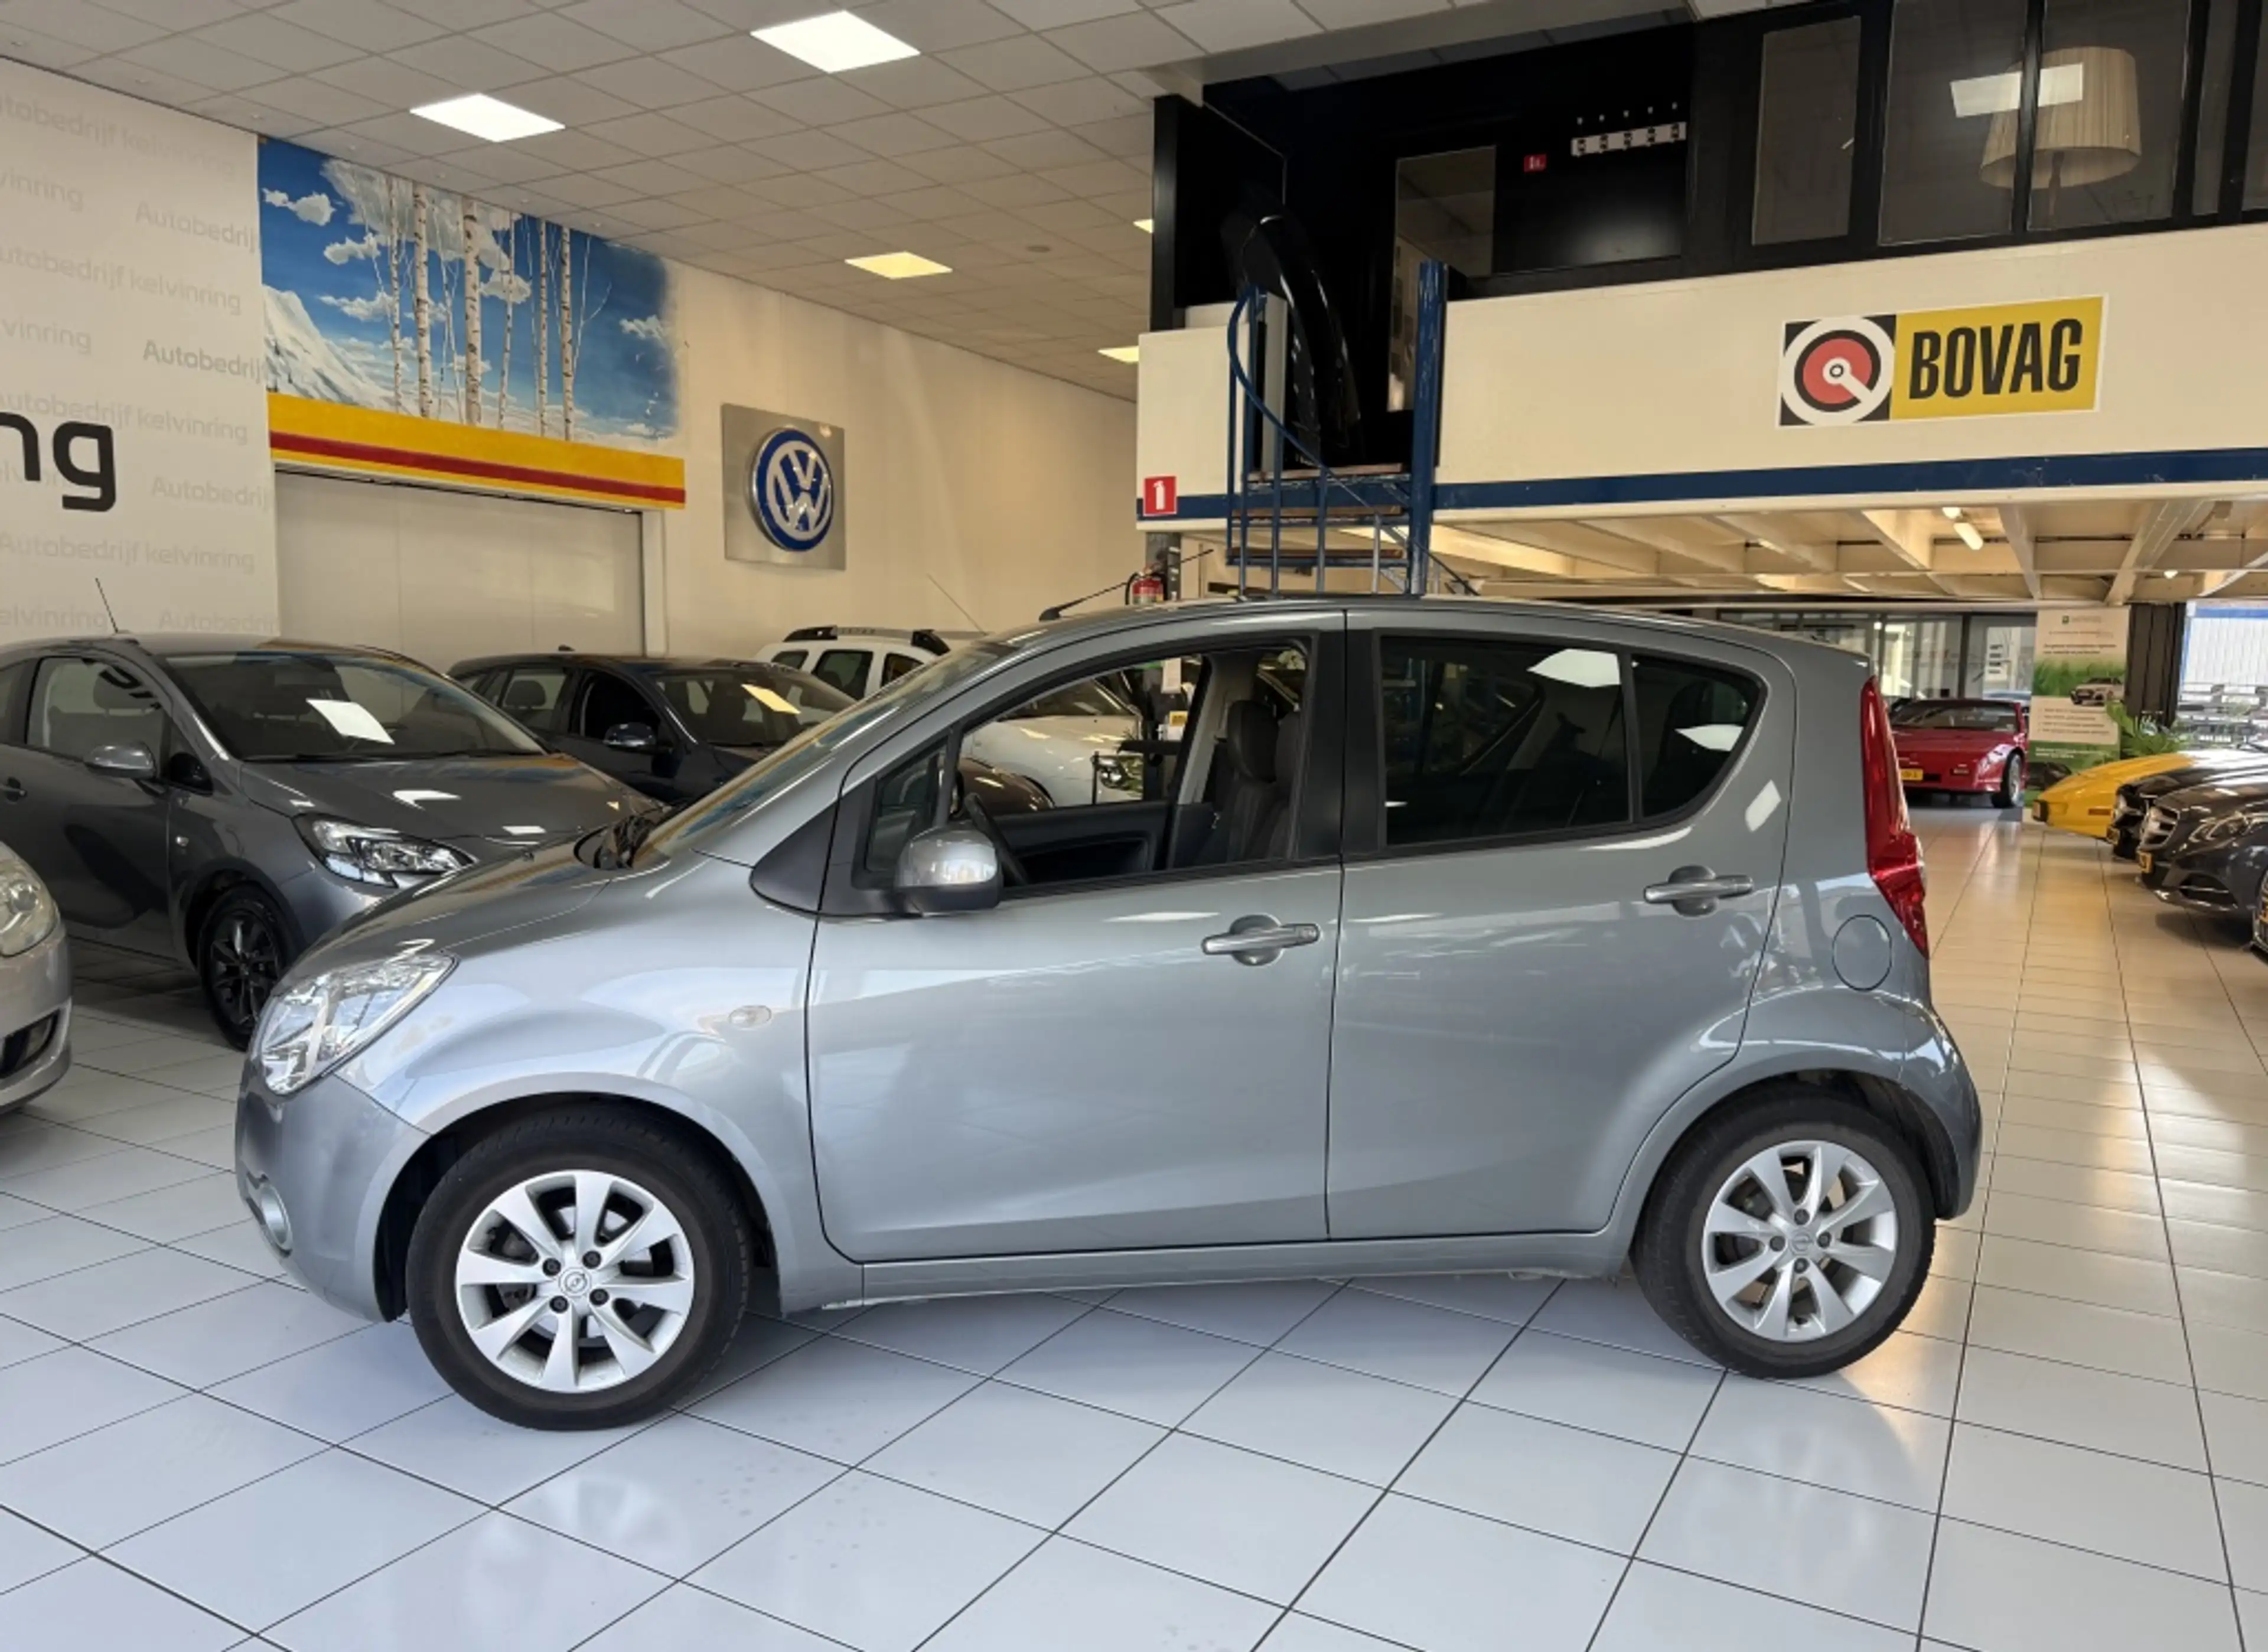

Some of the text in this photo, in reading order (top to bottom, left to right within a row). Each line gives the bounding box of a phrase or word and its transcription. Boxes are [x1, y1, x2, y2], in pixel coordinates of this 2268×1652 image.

[0, 91, 116, 147] tobedrijf
[130, 265, 241, 315] kelvinring
[1, 315, 91, 354] vinring
[1908, 318, 2083, 400] BOVAG
[138, 408, 247, 446] kelvinring
[146, 542, 255, 575] kelvinring
